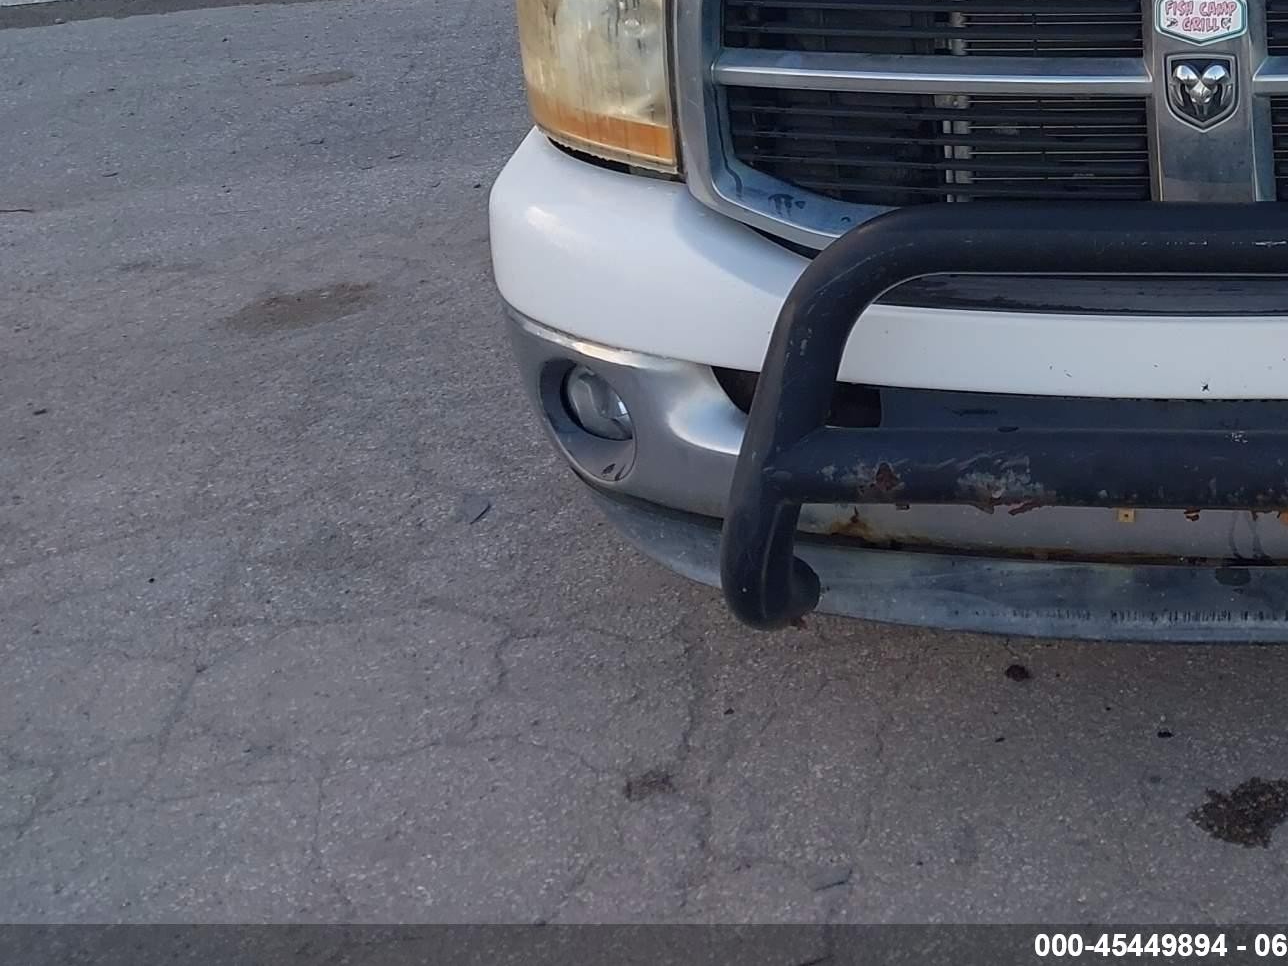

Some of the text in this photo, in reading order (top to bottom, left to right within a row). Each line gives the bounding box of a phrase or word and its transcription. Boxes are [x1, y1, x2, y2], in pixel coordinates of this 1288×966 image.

[1165, 0, 1237, 17] FISH CAMP
[1182, 17, 1220, 33] GRILL
